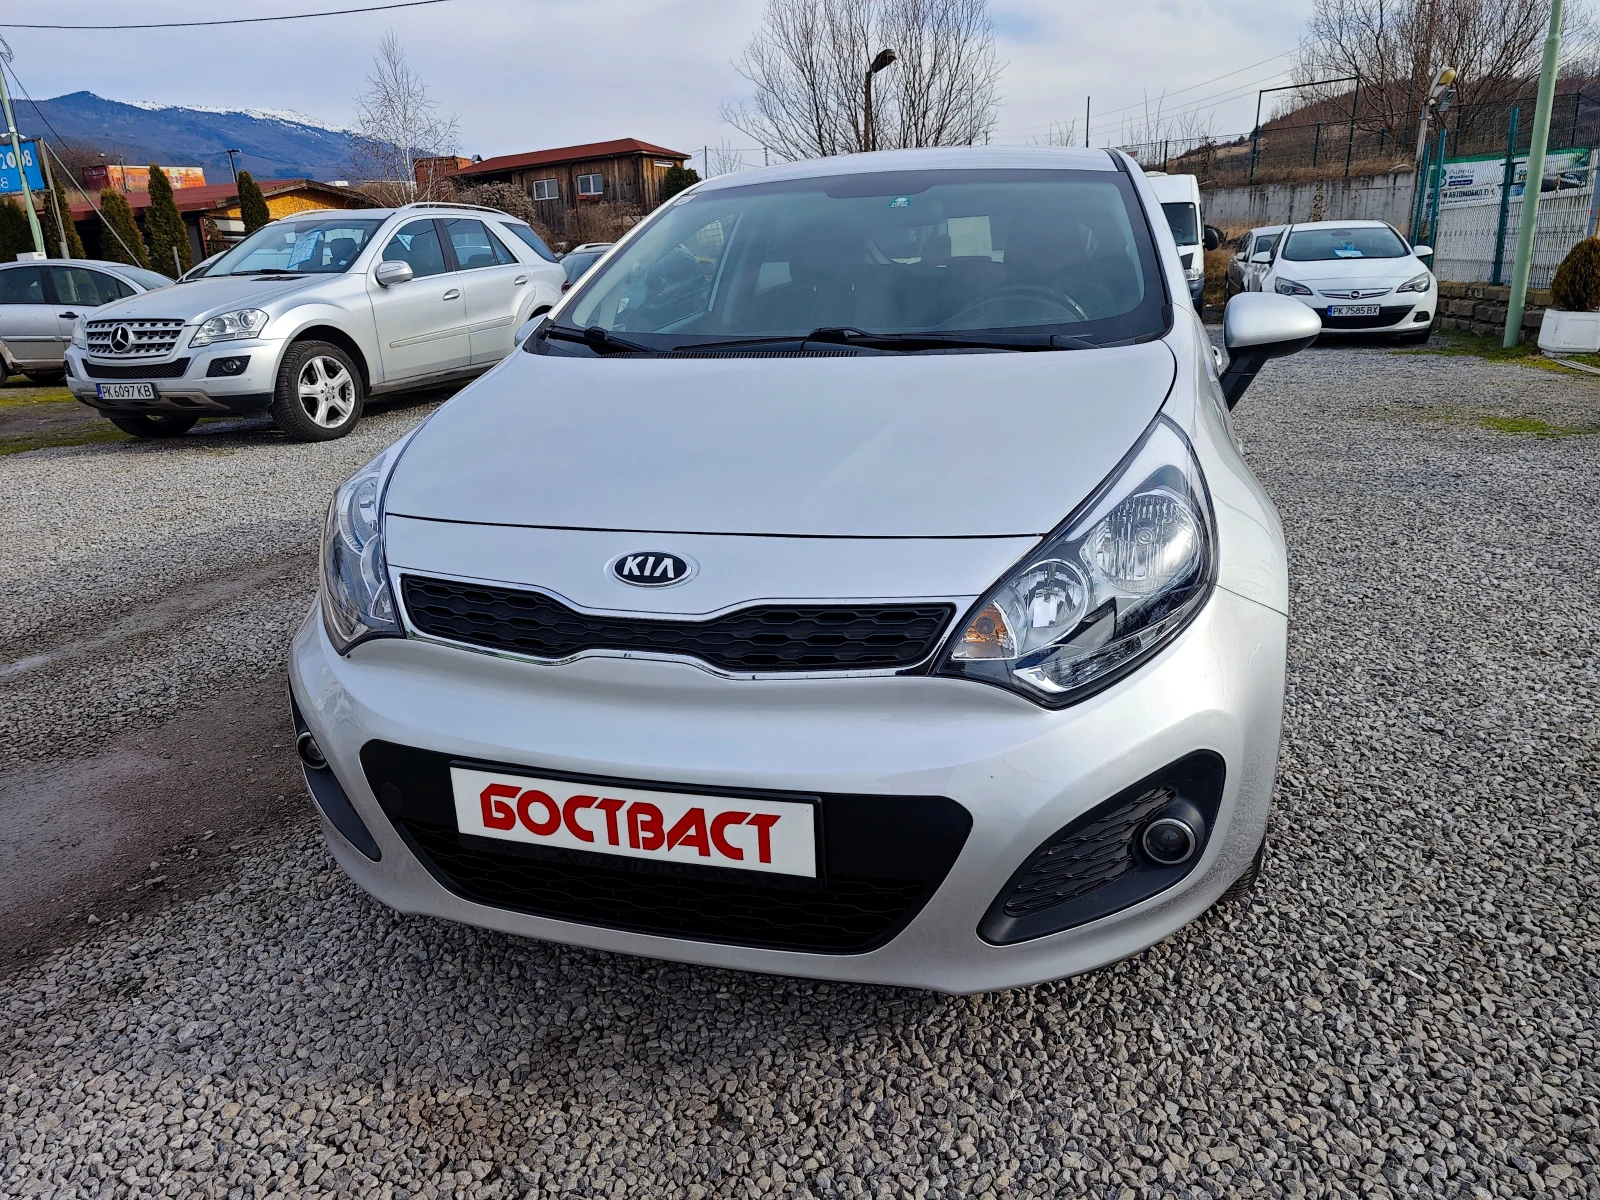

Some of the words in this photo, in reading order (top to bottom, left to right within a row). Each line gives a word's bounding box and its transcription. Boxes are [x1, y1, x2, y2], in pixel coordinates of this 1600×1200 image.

[1448, 189, 1483, 198] АВТОМОБИЛ
[1333, 306, 1343, 315] PK
[1345, 306, 1365, 315] 7585
[1367, 306, 1378, 315] BX
[102, 386, 113, 398] PK
[114, 385, 134, 398] 6097
[137, 385, 151, 397] KB
[622, 556, 675, 579] KIA
[480, 782, 782, 864] БОСТВАСТ
